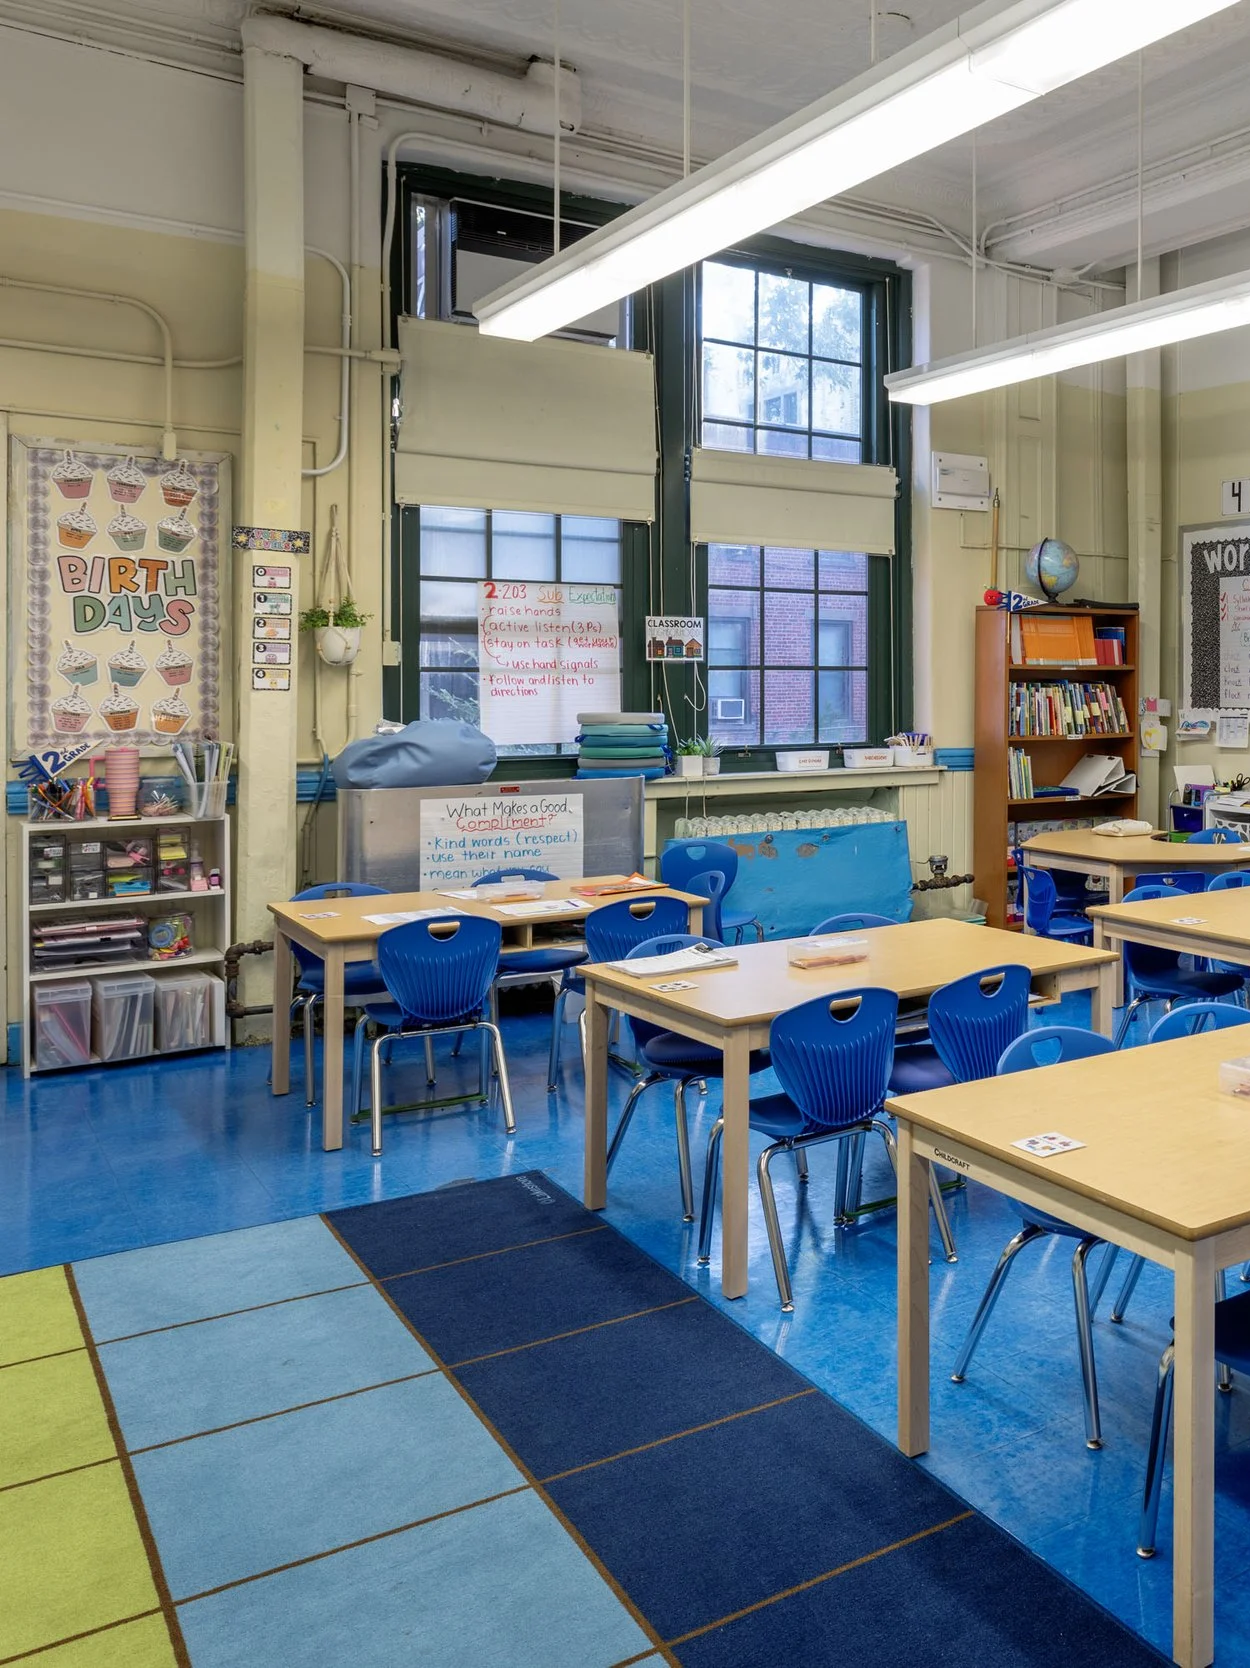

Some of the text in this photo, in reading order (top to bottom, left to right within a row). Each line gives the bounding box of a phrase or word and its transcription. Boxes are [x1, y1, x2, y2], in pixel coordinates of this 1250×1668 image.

[1232, 482, 1242, 513] 4
[57, 556, 198, 597] BIRTH
[537, 585, 564, 601] Sub
[73, 596, 195, 635] DAYS
[489, 605, 561, 616] raise hands
[489, 621, 530, 632] active
[535, 621, 571, 633] listen
[648, 620, 702, 628] CLASSROOM
[486, 639, 515, 652] stay
[517, 640, 531, 648] on
[535, 638, 565, 648] task
[512, 658, 599, 672] use hand signals
[528, 674, 547, 684] and
[548, 674, 579, 686] listen
[583, 674, 595, 685] to
[490, 686, 539, 697] directions
[63, 742, 91, 762] GRADE
[446, 798, 568, 818] What Makes a Good
[456, 813, 557, 833] Compliment?
[435, 829, 578, 850] Kind words (respect)
[462, 850, 497, 861] their
[504, 848, 542, 859] name
[430, 869, 468, 880] mean
[472, 866, 500, 879] wha
